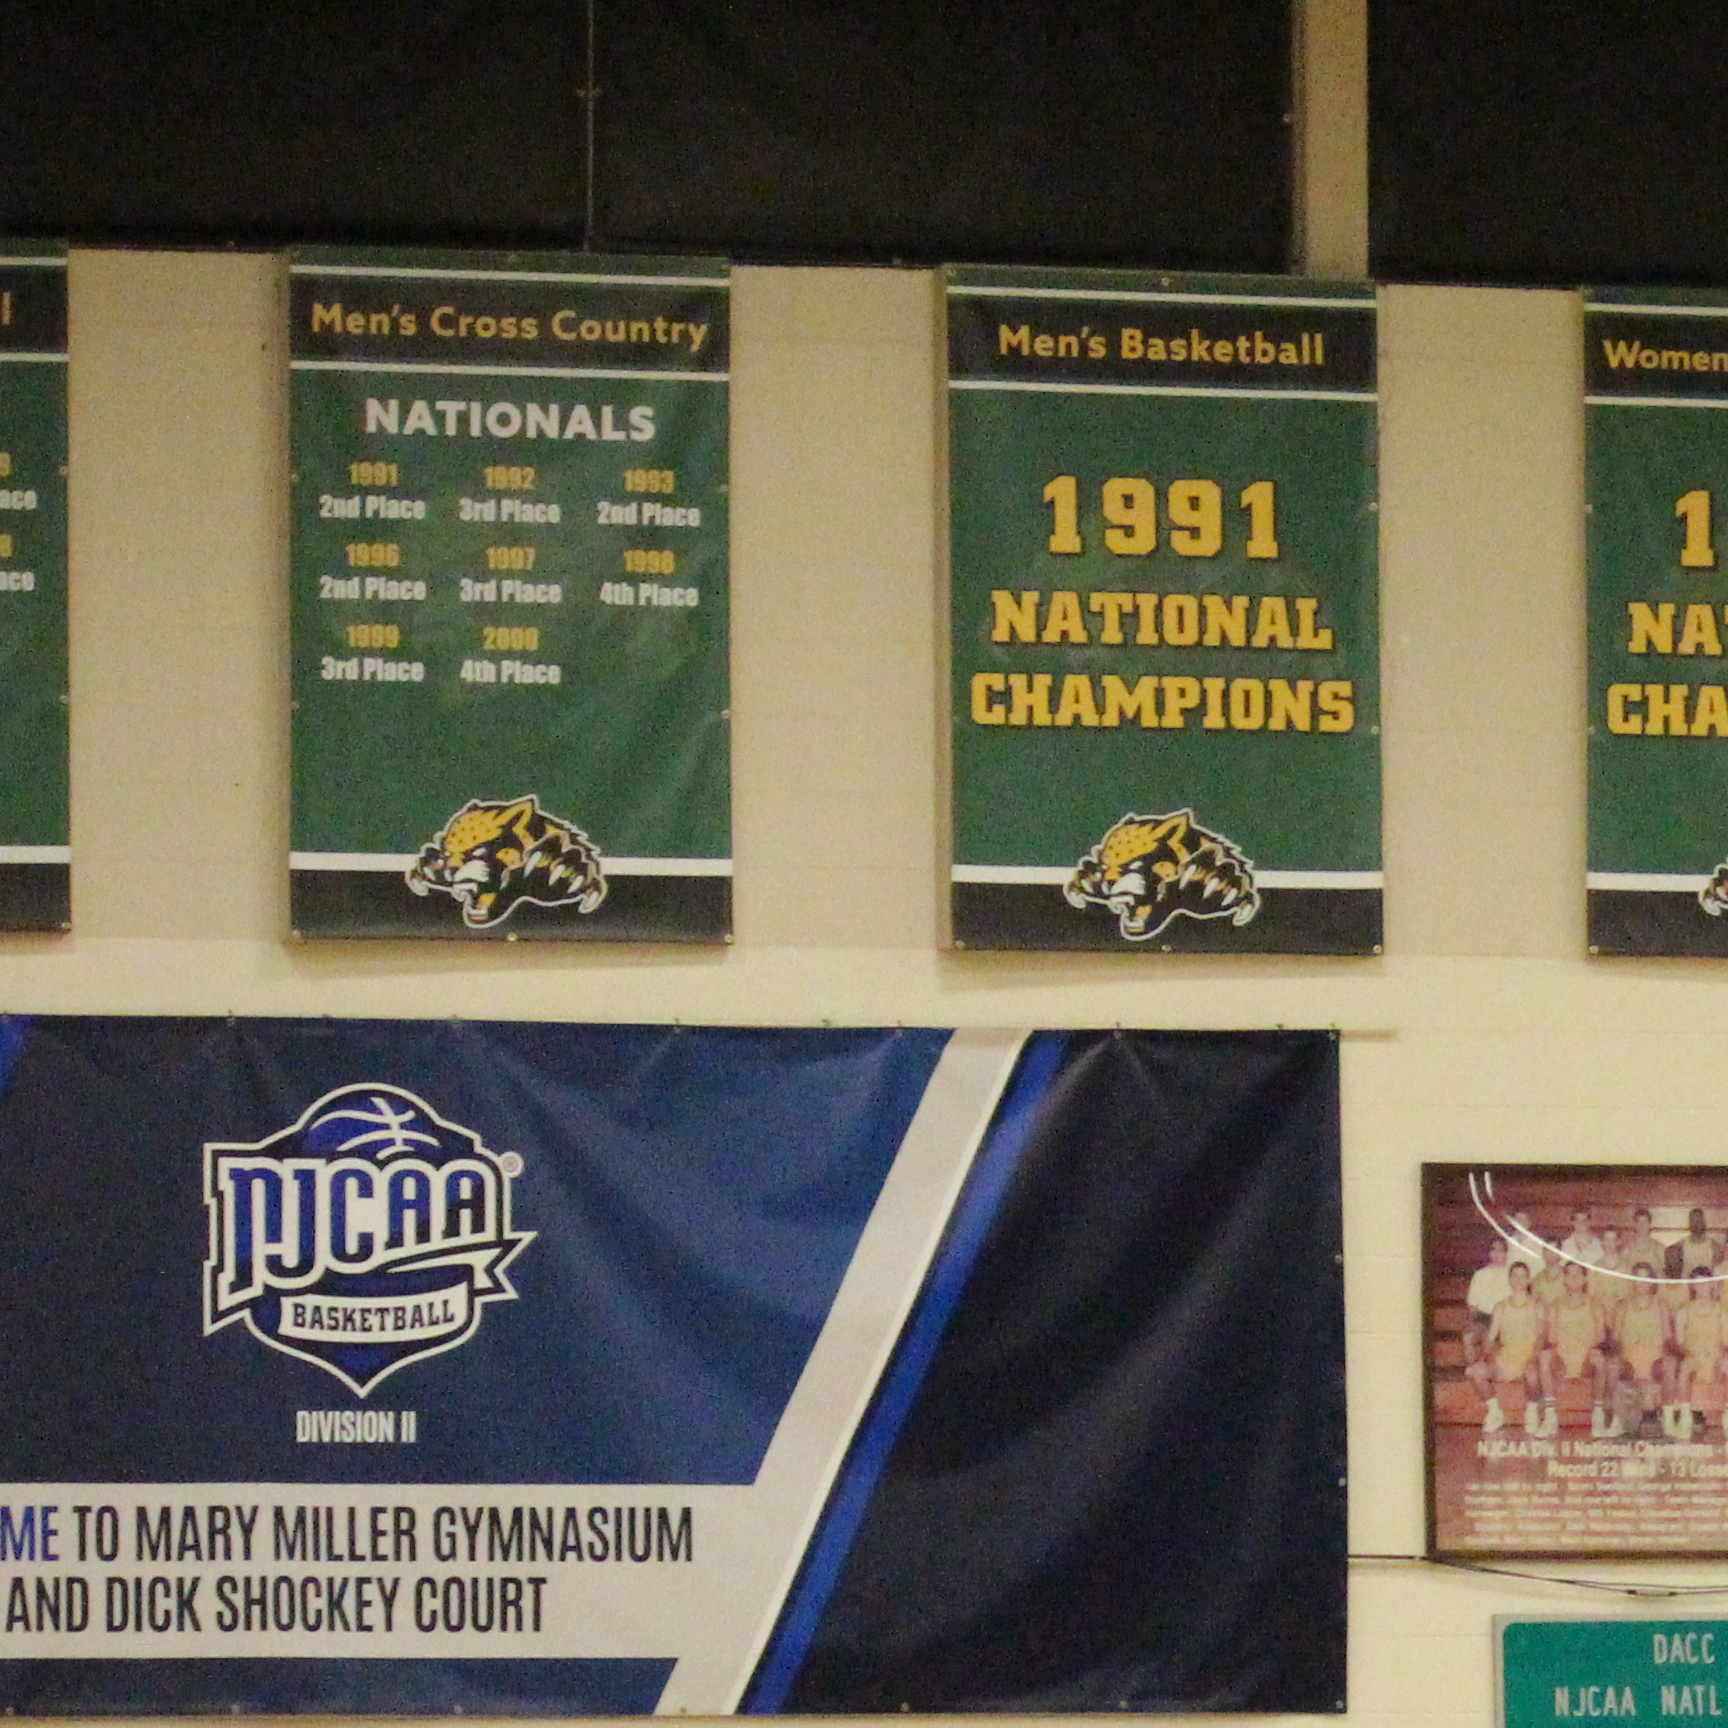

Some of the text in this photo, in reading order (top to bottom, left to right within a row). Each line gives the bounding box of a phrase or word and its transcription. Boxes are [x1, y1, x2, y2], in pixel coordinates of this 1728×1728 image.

[312, 303, 708, 353] Men's Cross Country
[1000, 324, 1324, 365] Men's Basketball
[365, 398, 656, 442] NATIONALS
[319, 495, 426, 520] 2nd Place
[459, 497, 562, 524] 3rd Place
[597, 501, 700, 527] 2nd Place
[1043, 475, 1278, 559] 1991
[320, 575, 426, 601] 2nd Place
[460, 578, 562, 603] 3rd Place
[600, 582, 699, 607] 4th Place
[991, 590, 1332, 650] NATIONAL
[322, 657, 424, 682] 3rd Place
[461, 659, 561, 684] 4th Place
[971, 673, 1354, 733] CHAMPIONS
[229, 1166, 494, 1294] NJCAA
[292, 1300, 456, 1333] BASKETBALL
[296, 1411, 416, 1444] DIVISION II
[74, 1506, 119, 1562] TO
[136, 1506, 258, 1562] MARY
[273, 1506, 416, 1562] MILLER
[432, 1506, 692, 1563] GYMNASIUM
[4, 1576, 547, 1633] AND DICK SHOCKEY COURT
[1653, 1633, 1715, 1664] DACC
[1555, 1686, 1636, 1716] NJCAA
